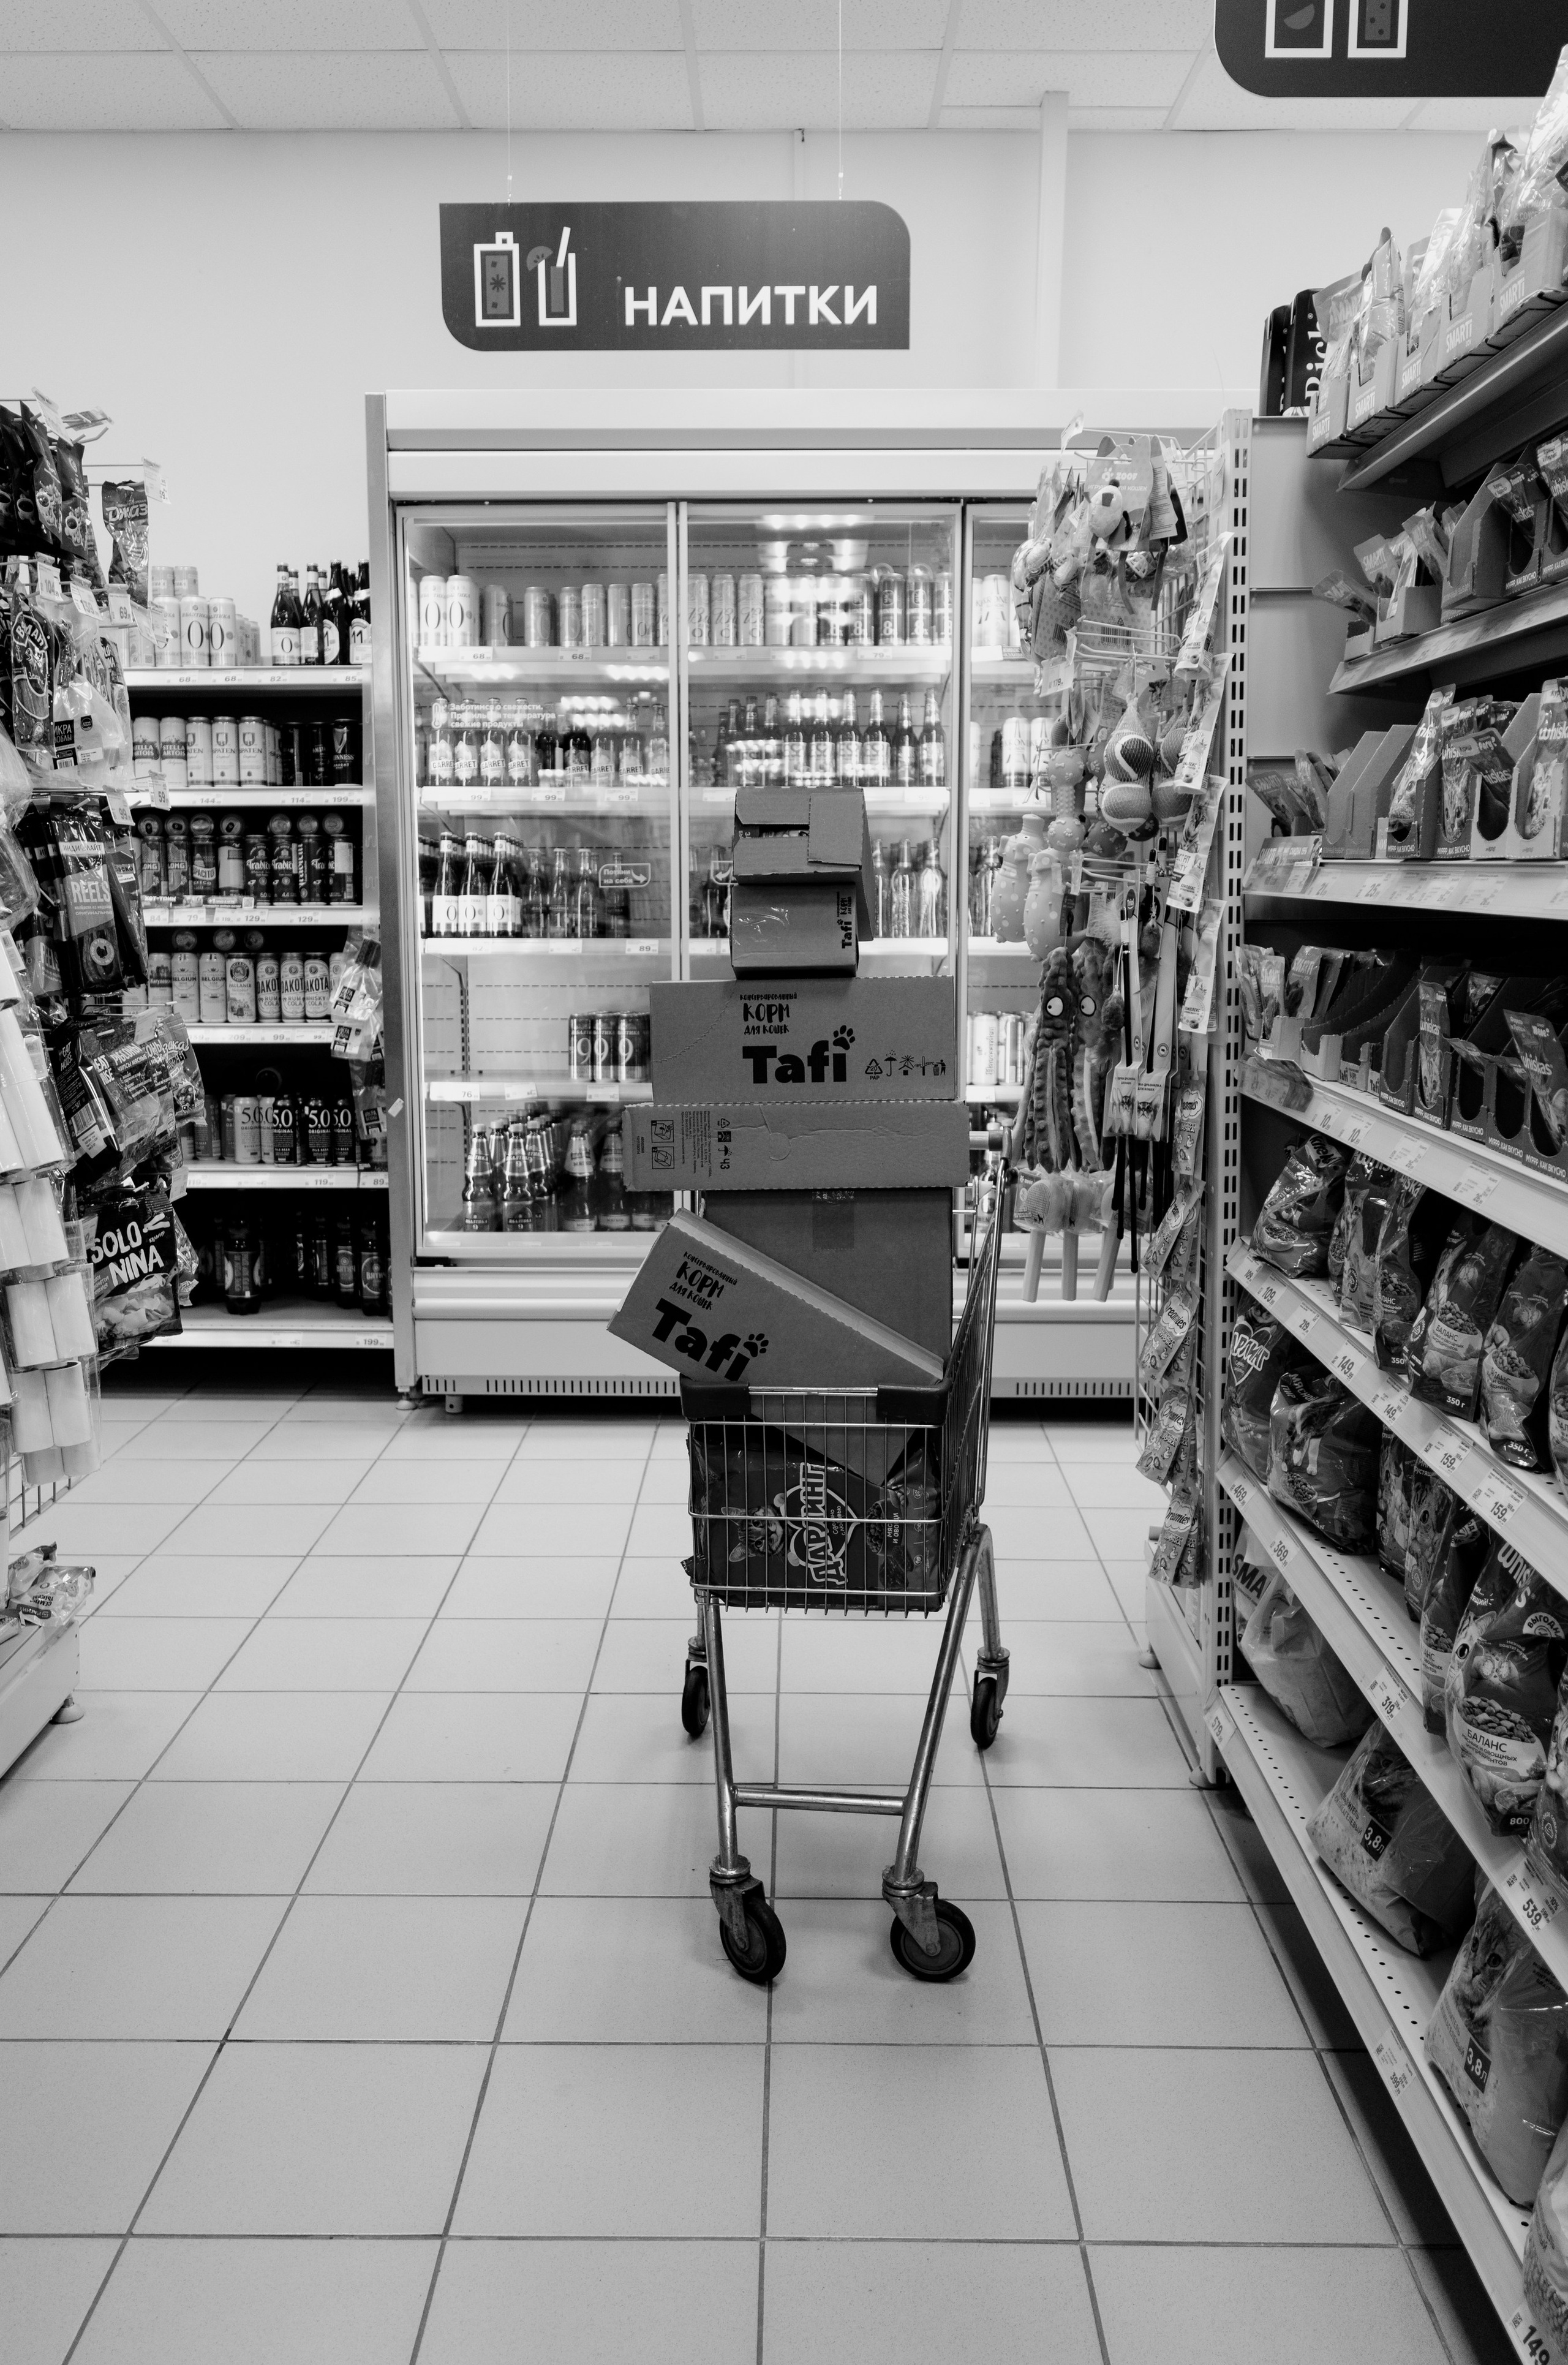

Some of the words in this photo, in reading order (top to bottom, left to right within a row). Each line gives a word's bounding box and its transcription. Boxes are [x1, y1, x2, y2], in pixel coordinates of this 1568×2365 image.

[625, 285, 878, 325] НАПИТКИ
[187, 620, 204, 649] 0
[211, 622, 224, 650] 0
[281, 636, 293, 653] 0
[70, 881, 111, 903] REELS
[842, 921, 852, 949] Tafi
[258, 978, 279, 994] DAKOT
[306, 977, 329, 992] AKOTA
[740, 992, 797, 1001] КОНСЕРВИРОВАННЫЙ
[742, 1003, 790, 1023] КОРМ
[744, 1025, 760, 1035] ДЛЯ
[763, 1024, 790, 1035] КОШЕК
[62, 1041, 71, 1057] EAT
[619, 1038, 633, 1063] 9
[742, 1040, 846, 1084] Tafi
[308, 1109, 331, 1128] 5,0
[1469, 1125, 1483, 1136] ВКУСНО
[1509, 1144, 1523, 1158] ВКУСНО
[1548, 1163, 1566, 1177] ВКУСНО
[90, 1221, 142, 1264] SOLO
[108, 1245, 165, 1287] NINA
[683, 1251, 737, 1286] КОНСЕРВИРОВАННЫЙ
[676, 1261, 725, 1298] КОРМ
[669, 1281, 688, 1297] ДЛЯ
[687, 1290, 713, 1310] КОШЕК
[1262, 1286, 1276, 1303] 109
[1298, 1319, 1310, 1331] 219
[1436, 1324, 1458, 1342] БАЛАНС
[652, 1297, 750, 1382] Tafi
[1337, 1356, 1355, 1375] 149
[1281, 1384, 1297, 1400] ПИР
[1447, 1396, 1460, 1406] 350
[1384, 1403, 1397, 1419] 149
[1440, 1452, 1456, 1469] 159
[1234, 1484, 1248, 1502] 469
[1490, 1501, 1508, 1520] 159
[1273, 1540, 1289, 1562] 369
[1382, 1695, 1395, 1715] 319
[1212, 1716, 1223, 1737] 579
[1468, 1729, 1507, 1752] БАЛАНС
[1483, 1748, 1517, 1762] овощных
[1510, 1817, 1529, 1825] 800
[1523, 1898, 1542, 1926] 539
[1467, 2048, 1487, 2083] 3,8л
[1390, 2072, 1400, 2088] 399
